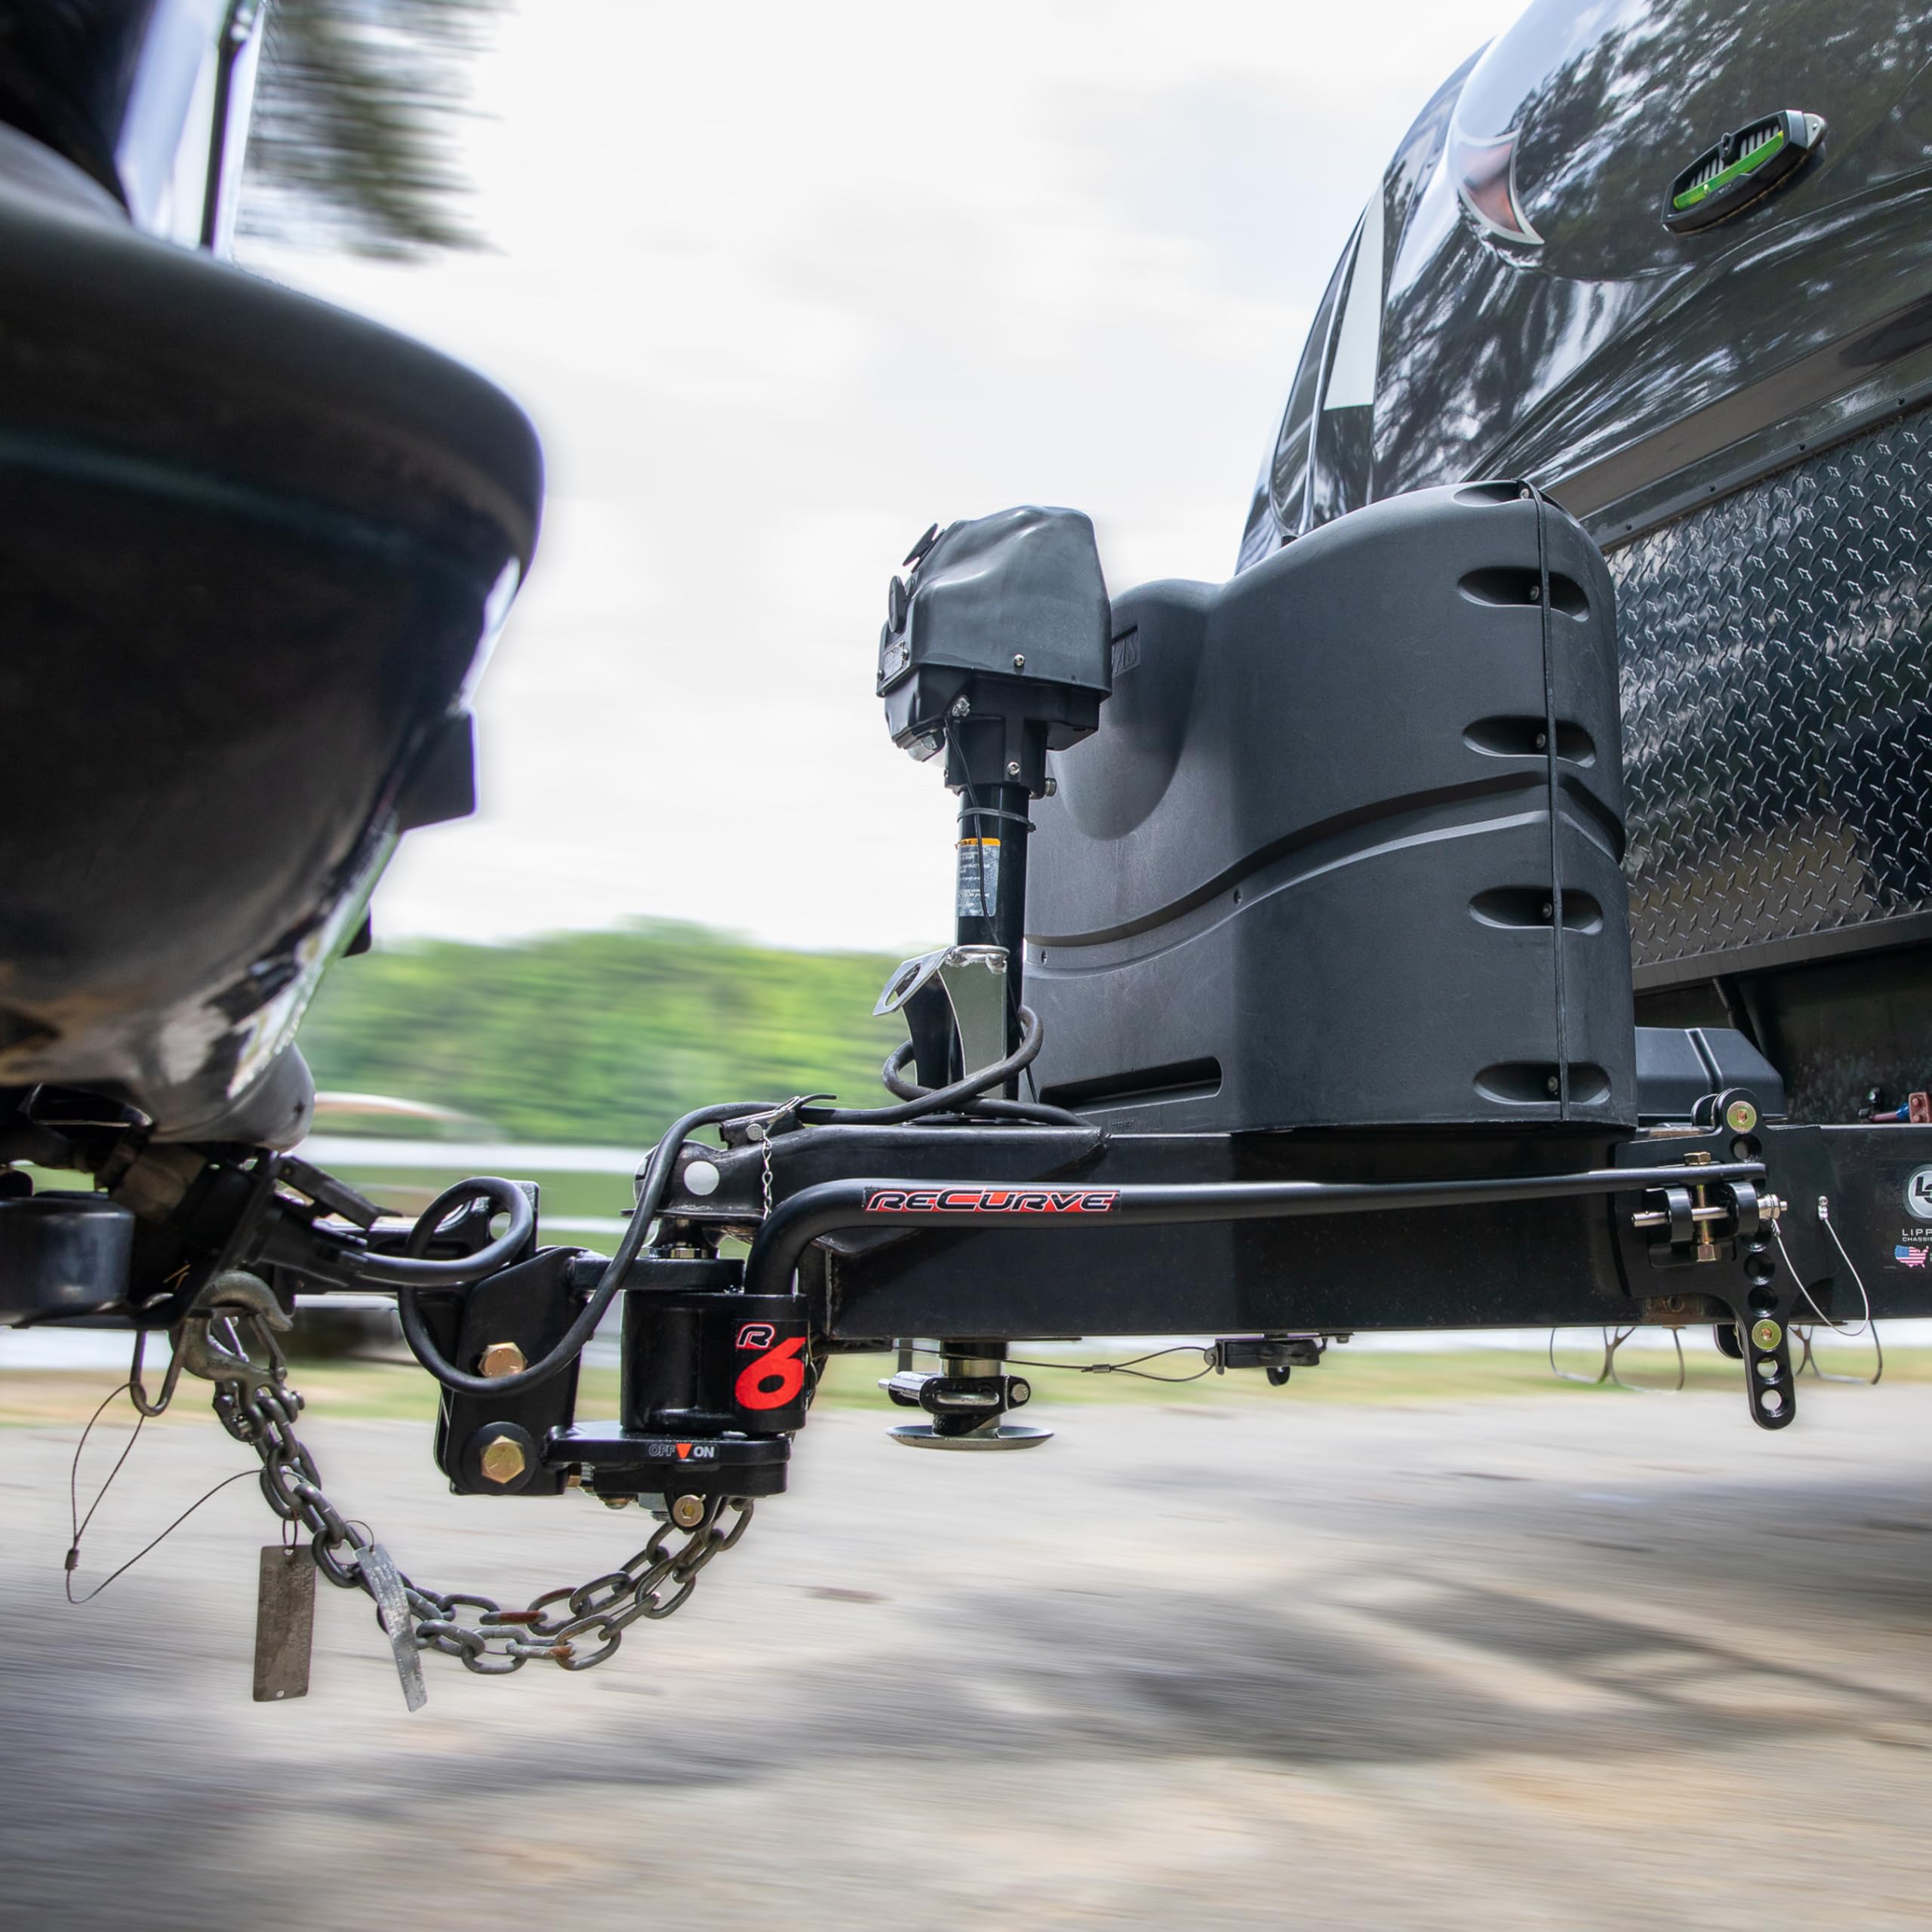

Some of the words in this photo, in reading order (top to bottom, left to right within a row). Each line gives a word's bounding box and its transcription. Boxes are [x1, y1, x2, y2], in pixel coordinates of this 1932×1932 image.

[737, 1323, 775, 1349] R
[735, 1337, 807, 1410] 6
[649, 1444, 676, 1457] OFF
[694, 1446, 715, 1457] ON
